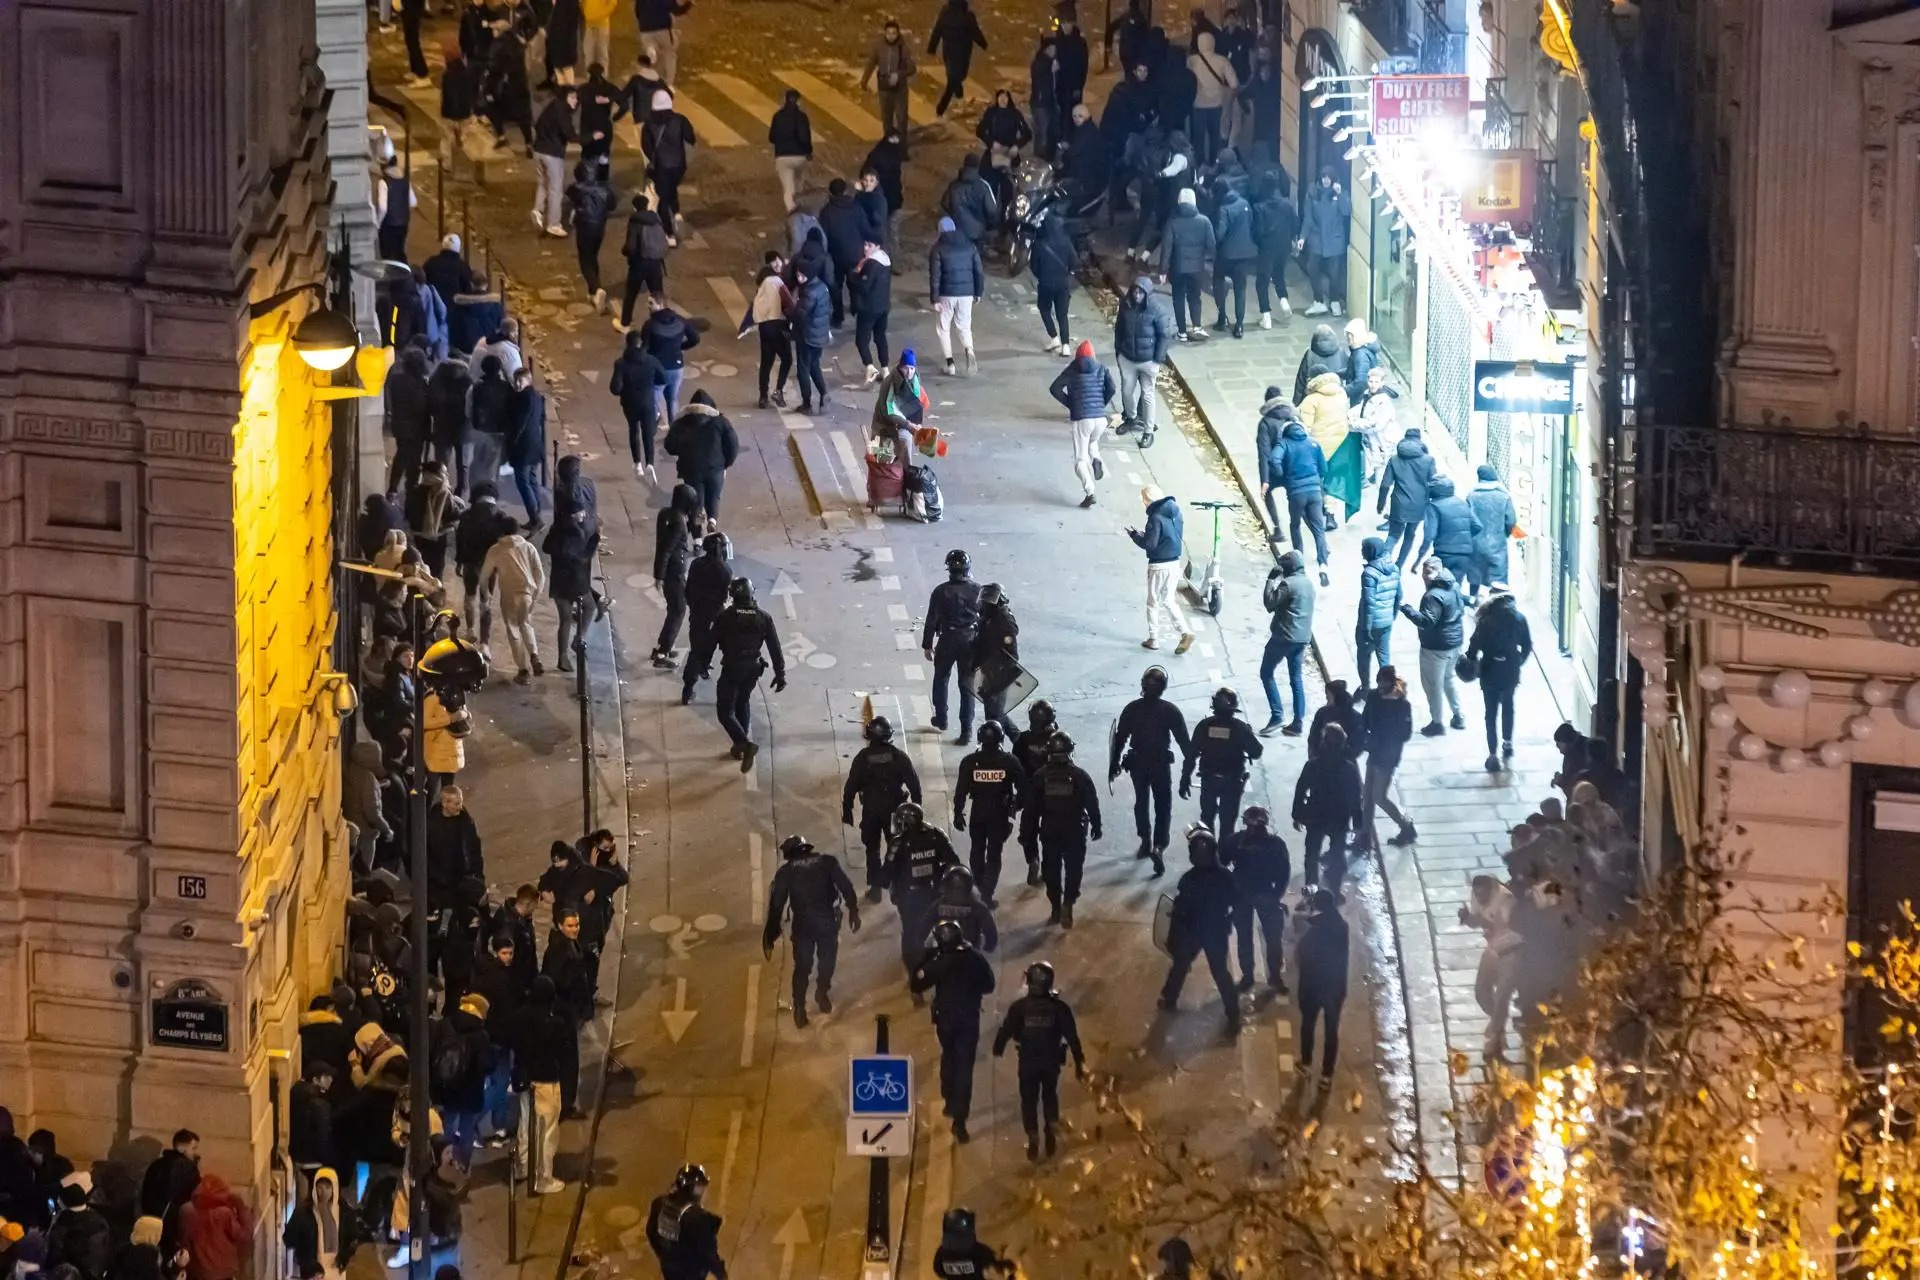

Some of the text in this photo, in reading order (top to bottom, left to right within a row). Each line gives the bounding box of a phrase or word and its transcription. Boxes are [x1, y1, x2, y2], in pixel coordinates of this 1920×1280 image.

[1382, 82, 1462, 99] DUTY FREE
[1400, 101, 1444, 116] GIFTS
[1478, 196, 1511, 206] Kodak
[1478, 376, 1570, 401] CGE
[975, 771, 1004, 780] POLICE
[911, 849, 935, 860] POLICE
[180, 878, 205, 897] 156
[175, 1010, 205, 1021] AVENUE
[159, 1028, 189, 1039] CHAMPS
